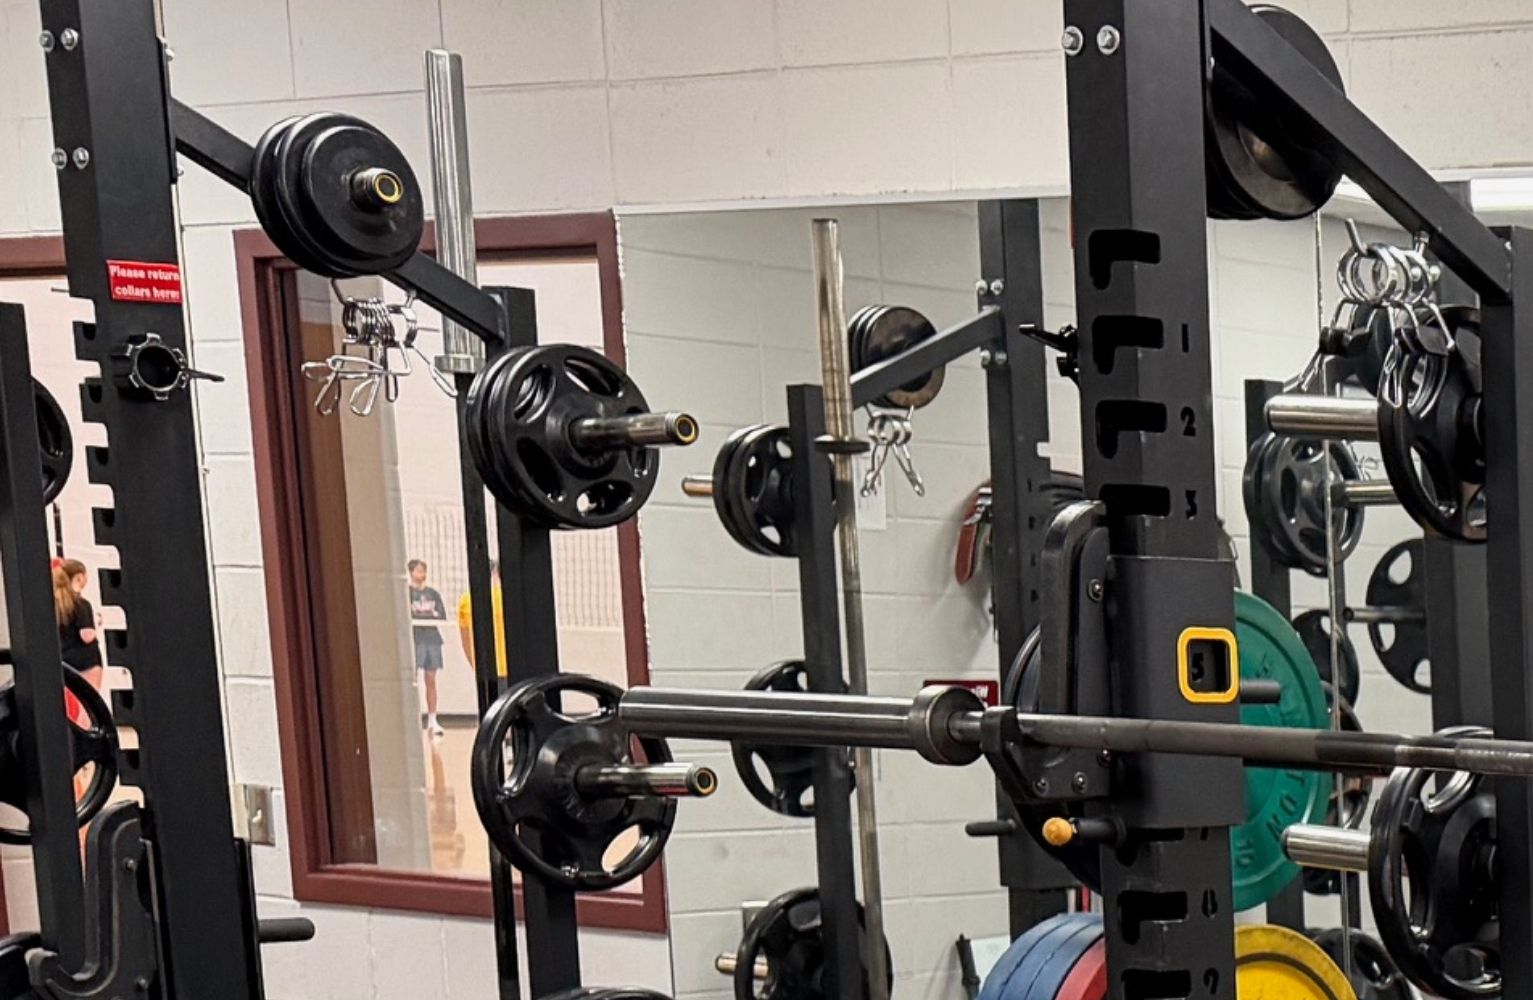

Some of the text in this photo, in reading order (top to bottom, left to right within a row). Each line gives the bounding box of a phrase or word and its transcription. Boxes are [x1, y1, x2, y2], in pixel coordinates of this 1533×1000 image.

[109, 265, 180, 281] Please return
[115, 284, 151, 298] collars
[1180, 406, 1196, 436] 2
[1202, 888, 1218, 918] 8
[1203, 967, 1220, 995] 9
